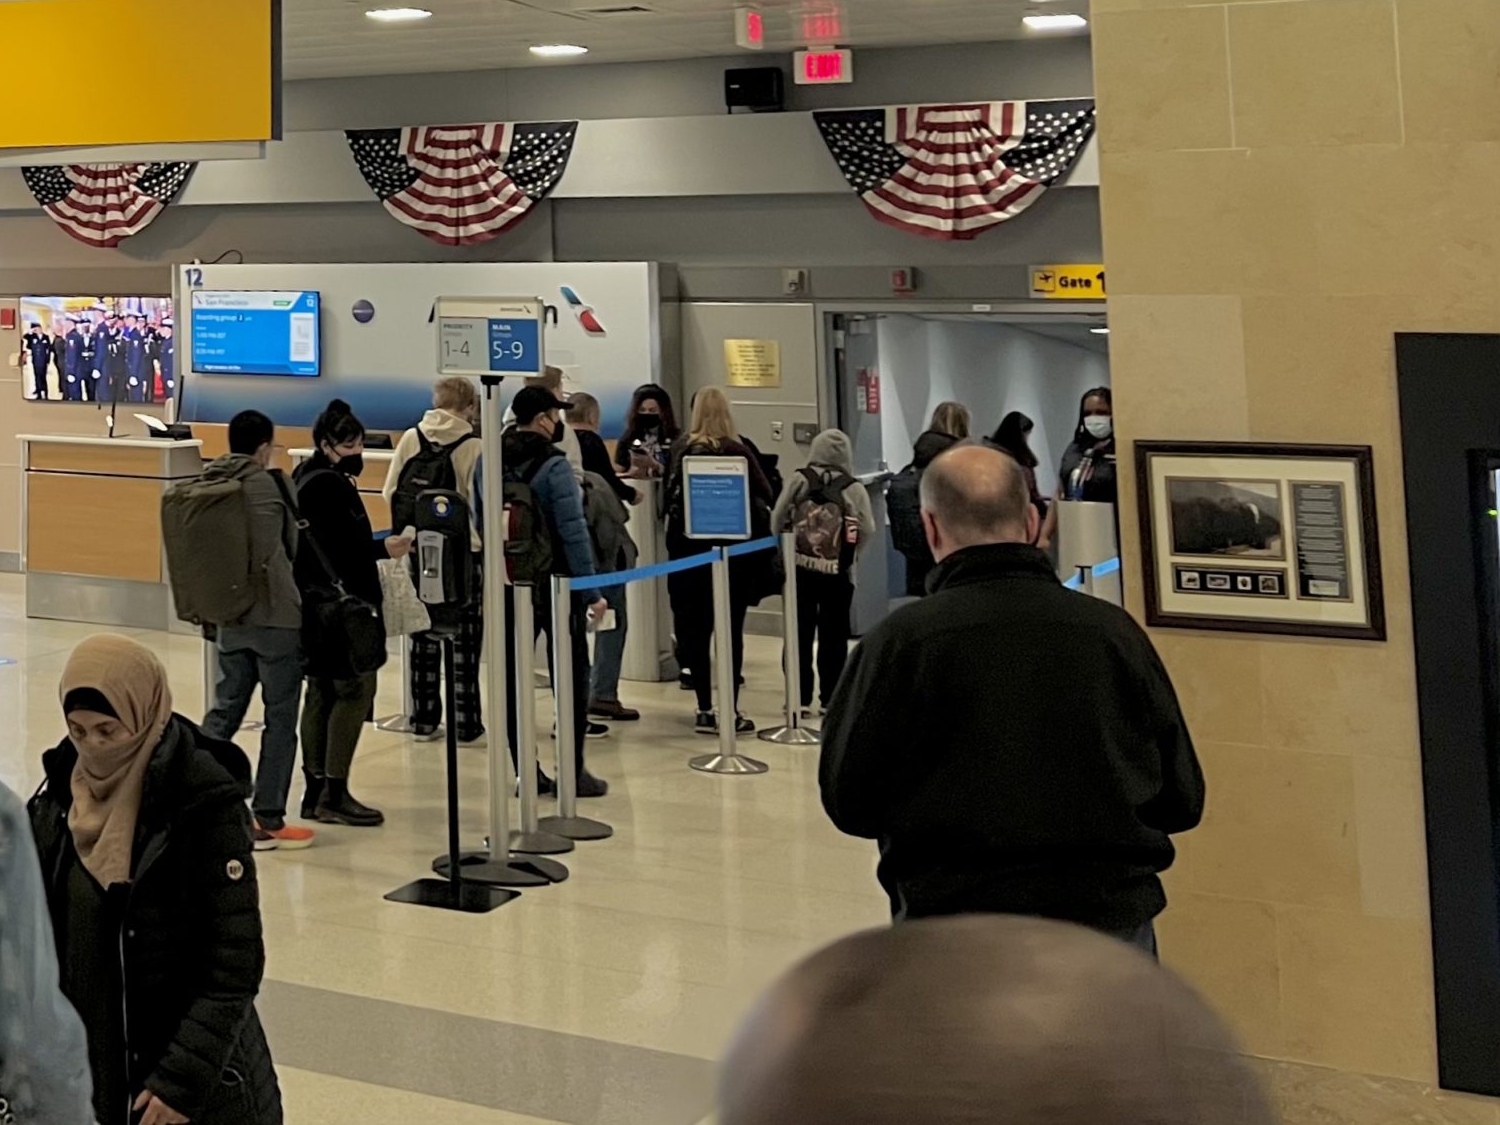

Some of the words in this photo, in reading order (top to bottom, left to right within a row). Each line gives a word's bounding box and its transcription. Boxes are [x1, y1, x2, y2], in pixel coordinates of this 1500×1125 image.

[804, 52, 842, 81] EXIT
[185, 268, 203, 287] 12
[1059, 276, 1092, 288] Gate
[205, 298, 217, 307] San
[220, 298, 248, 307] Francisco
[444, 340, 470, 357] 1-4
[492, 341, 524, 360] 5-9
